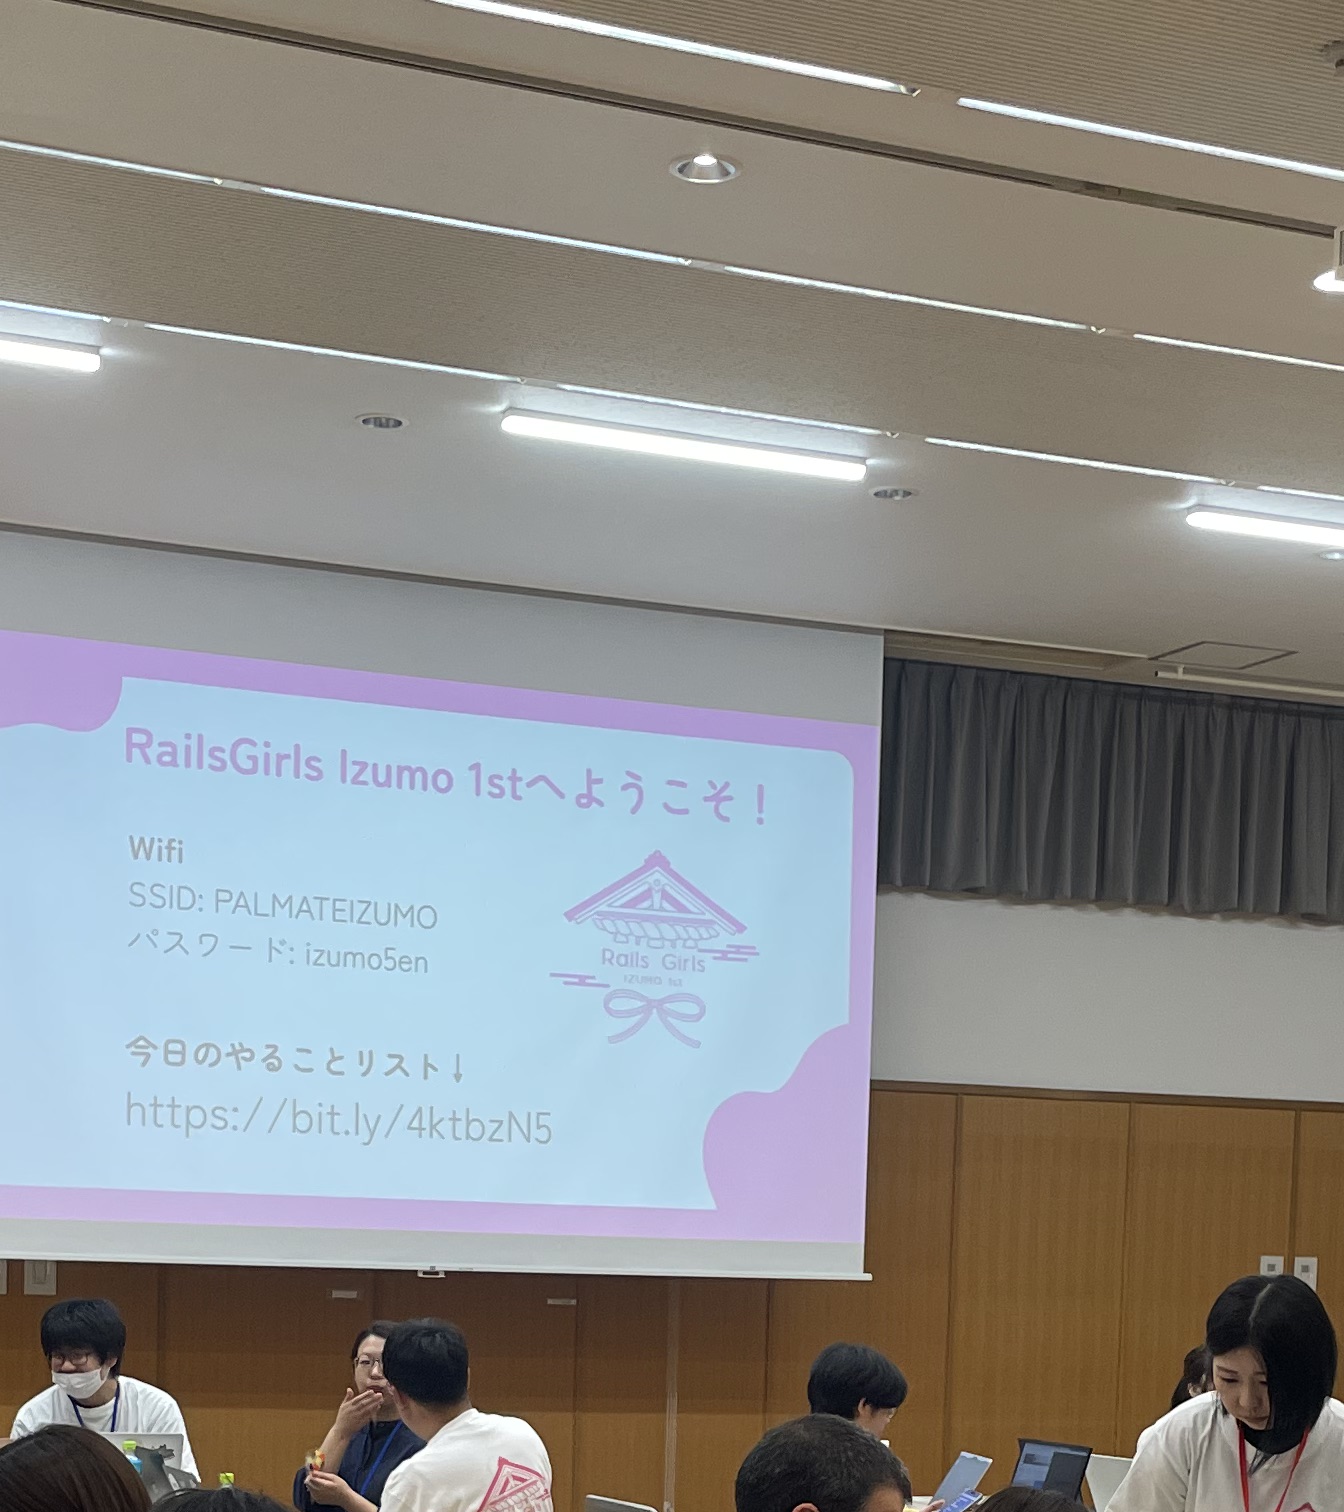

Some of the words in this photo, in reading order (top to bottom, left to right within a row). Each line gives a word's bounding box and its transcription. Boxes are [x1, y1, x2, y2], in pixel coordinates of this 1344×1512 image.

[125, 727, 324, 782] RailsGirls
[340, 749, 454, 794] Izumo
[128, 835, 184, 864] Wifi
[128, 882, 204, 912] SSID:
[214, 889, 438, 930] PALMATEIZUMO
[128, 929, 295, 964] パスワード:
[306, 942, 428, 974] izumo5en
[601, 948, 650, 969] Rails
[661, 953, 706, 973] Girls
[125, 1091, 553, 1147] https://bit.ly/4ktbzN5
